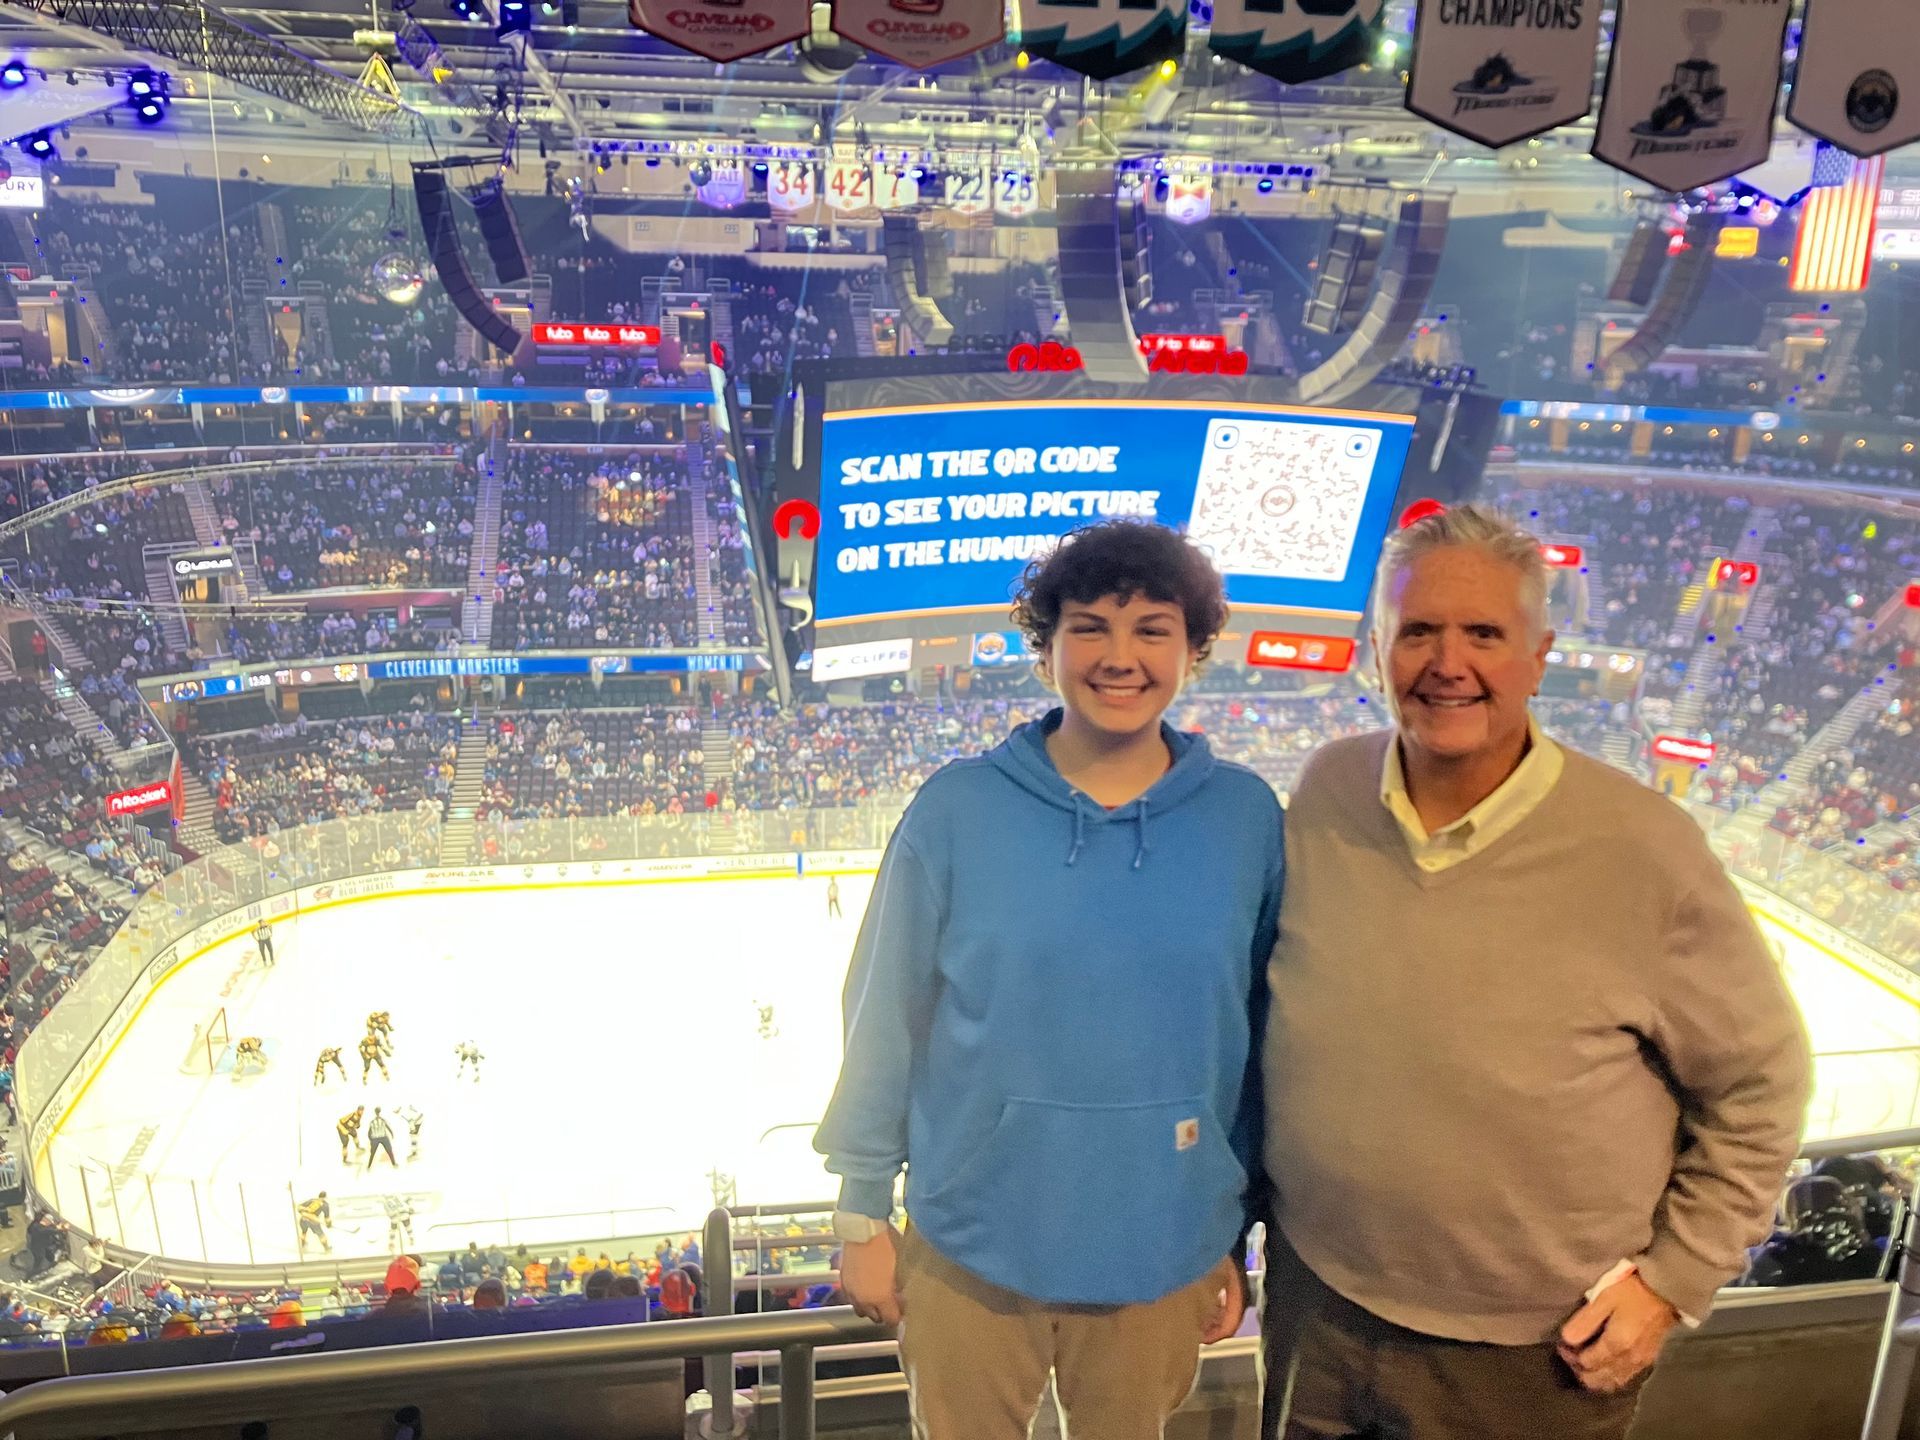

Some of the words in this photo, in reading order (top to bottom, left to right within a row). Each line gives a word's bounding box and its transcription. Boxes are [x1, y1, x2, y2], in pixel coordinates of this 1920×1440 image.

[1439, 0, 1583, 30] CHAMPIONS
[774, 168, 809, 196] 34
[832, 168, 864, 197] 42
[840, 453, 922, 485] SCAN
[927, 449, 990, 477] THE
[993, 448, 1037, 477] QR
[1040, 446, 1120, 473] CODE
[839, 502, 881, 529] TO
[884, 497, 942, 526] SEE
[947, 492, 1027, 521] YOUR
[1030, 491, 1160, 517] PICTURE
[836, 545, 880, 573] ON
[884, 540, 945, 568] THE
[385, 660, 451, 678] CLEVELAND
[456, 658, 519, 674] MONSTERS
[686, 655, 726, 671] WOMEN
[730, 655, 742, 670] IN
[850, 649, 908, 665] CLIFFS
[123, 786, 166, 808] Rocket
